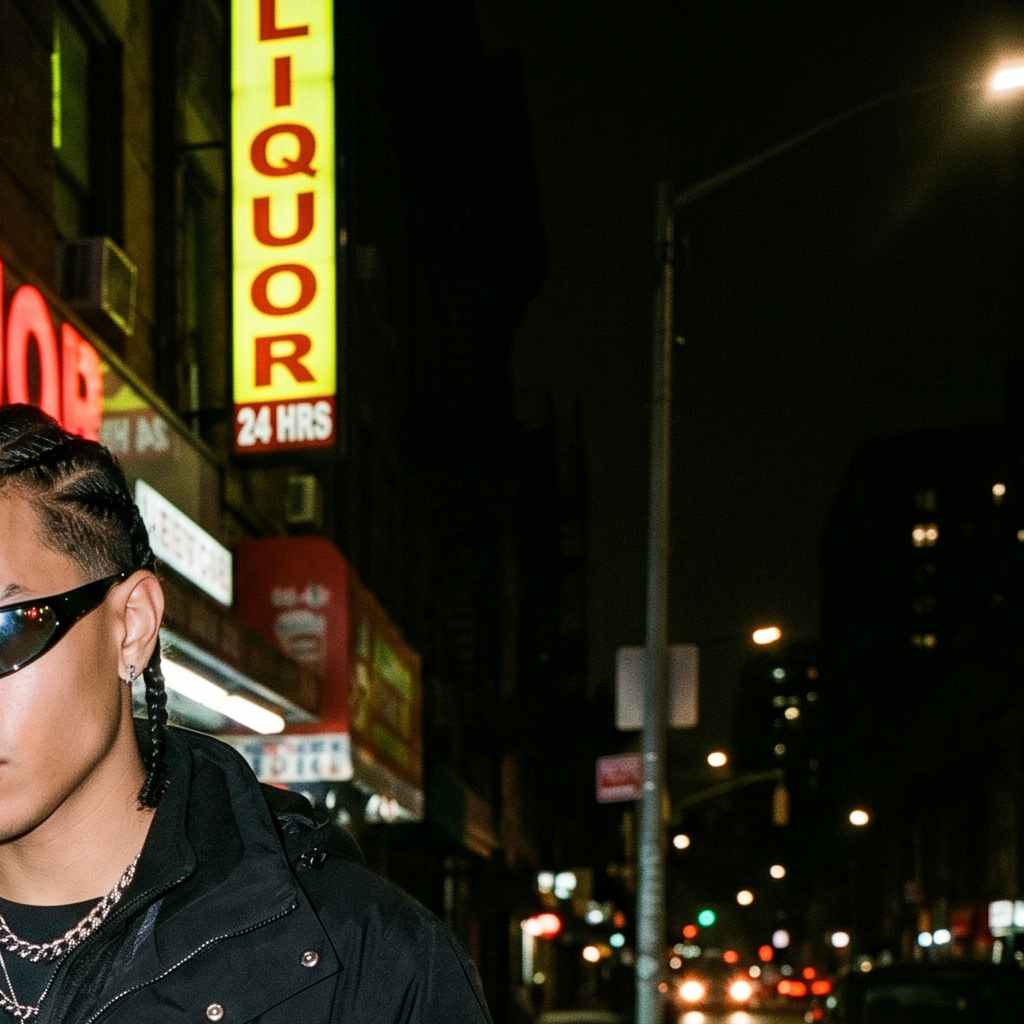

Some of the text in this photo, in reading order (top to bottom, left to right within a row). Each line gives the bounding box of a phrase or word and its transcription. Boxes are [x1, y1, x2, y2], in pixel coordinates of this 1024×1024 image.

[249, 0, 318, 389] LIQUOR
[236, 400, 333, 447] 24 HRS
